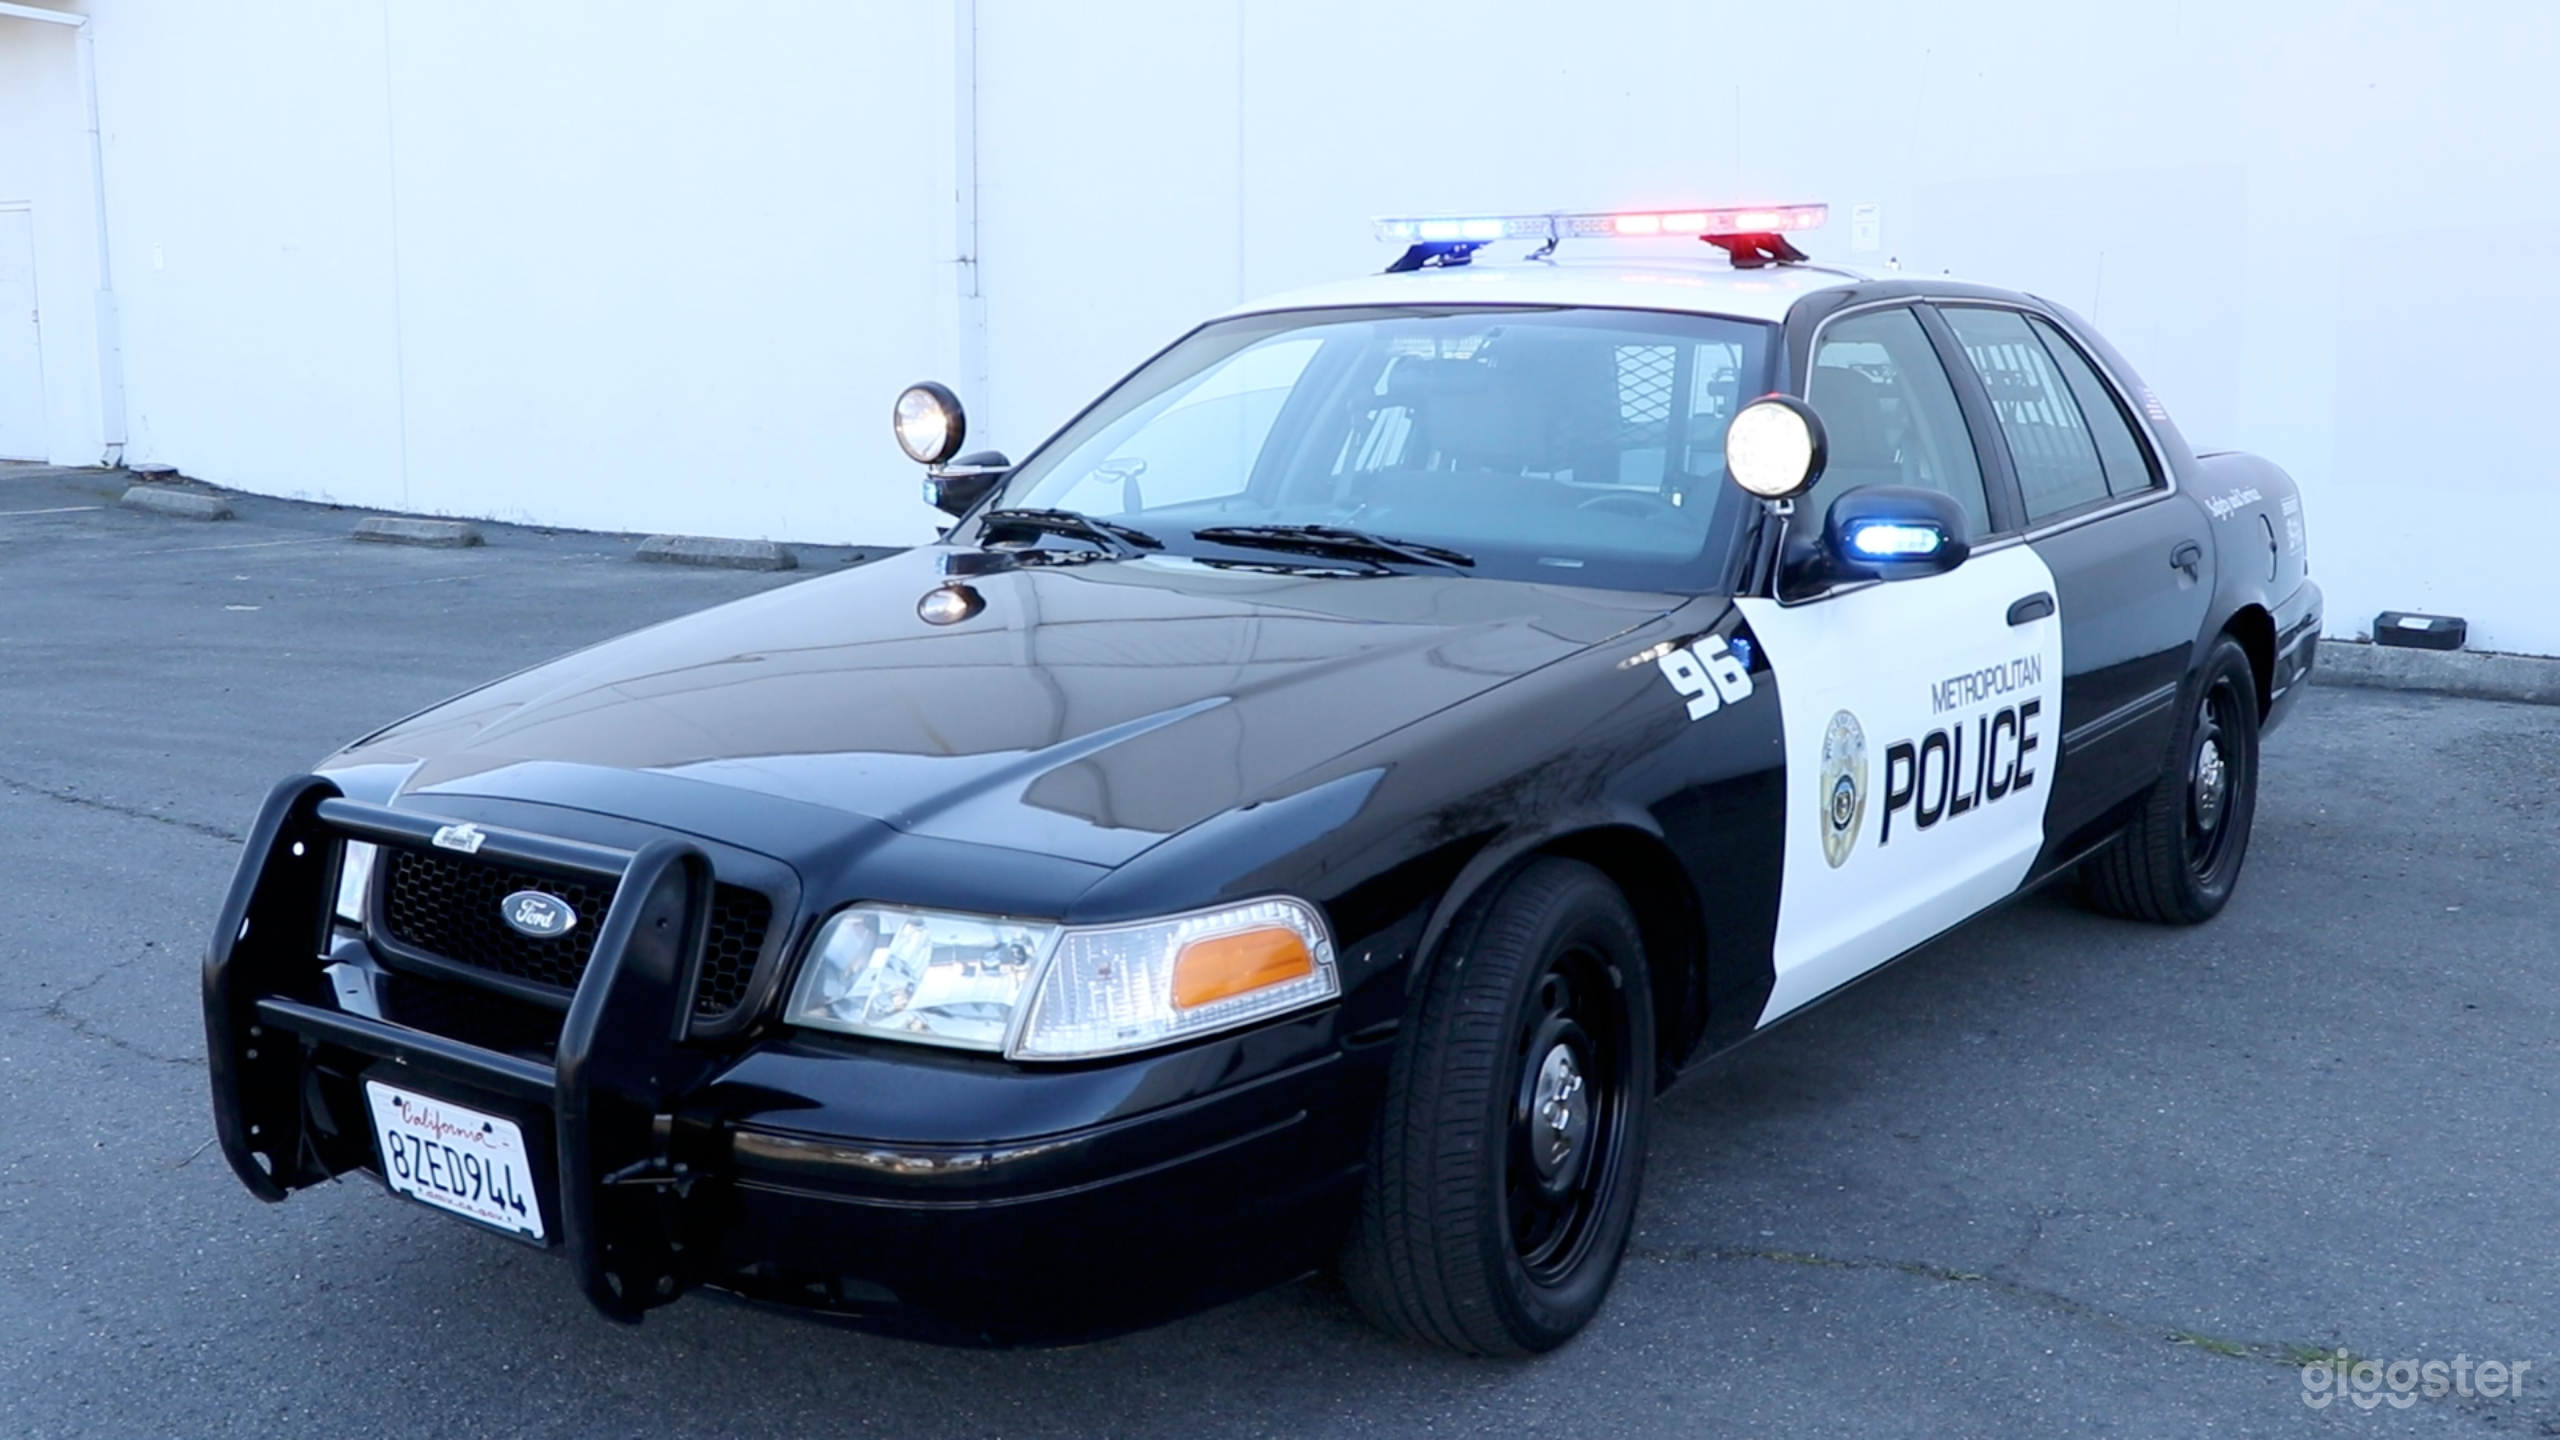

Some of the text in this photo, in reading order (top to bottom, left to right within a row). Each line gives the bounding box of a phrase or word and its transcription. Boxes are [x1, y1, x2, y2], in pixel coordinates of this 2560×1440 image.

[1658, 633, 1754, 722] 96
[1932, 654, 2041, 715] METROPOLITAN
[1878, 697, 2041, 848] POLICE
[515, 899, 556, 928] Ford
[402, 1101, 496, 1148] California
[388, 1130, 526, 1217] 8ZED944
